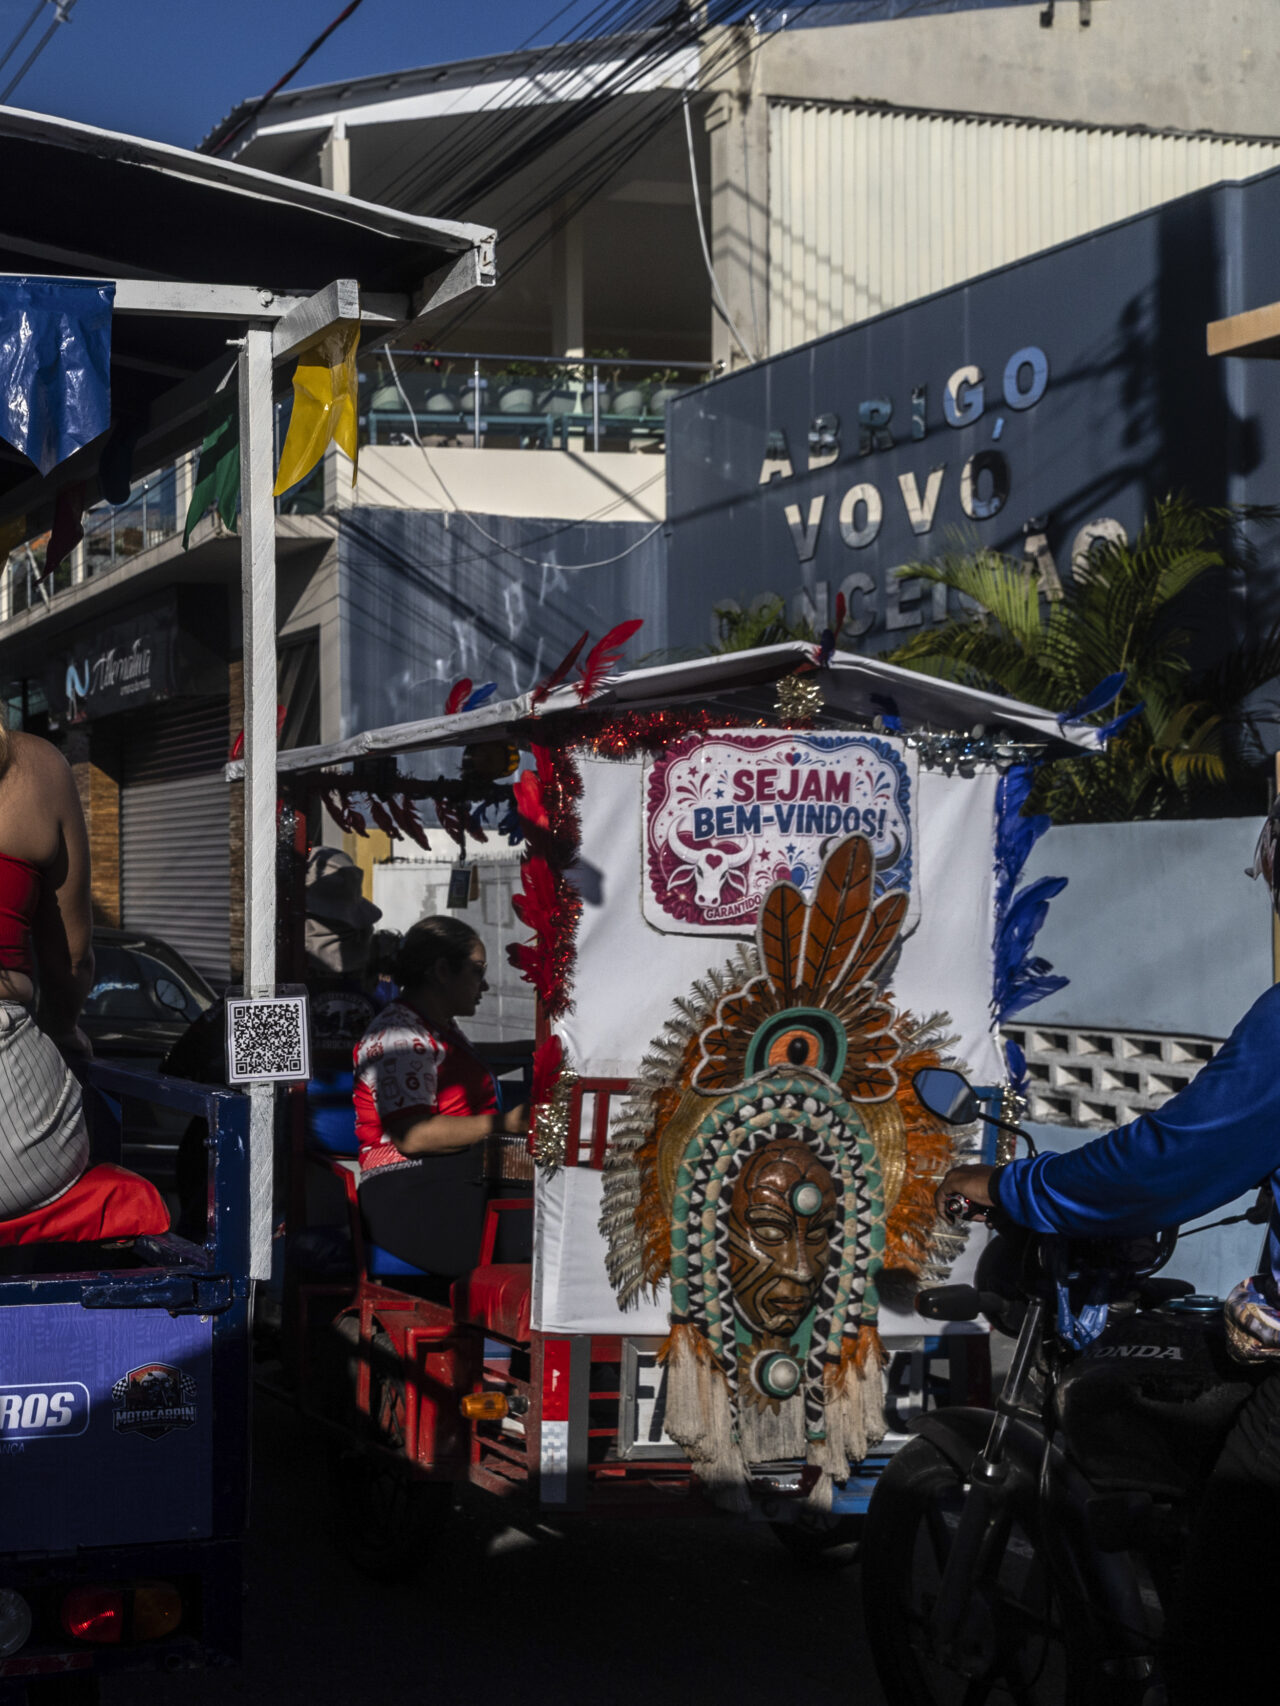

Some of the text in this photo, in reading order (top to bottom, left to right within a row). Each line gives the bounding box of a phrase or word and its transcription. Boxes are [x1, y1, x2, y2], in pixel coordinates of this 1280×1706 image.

[758, 346, 1049, 485] ABRIGO
[784, 418, 1011, 562] VOVÓ
[733, 769, 851, 803] SEJAM
[694, 804, 887, 839] BEM-VINDOS!
[706, 895, 761, 919] GARANTIDO
